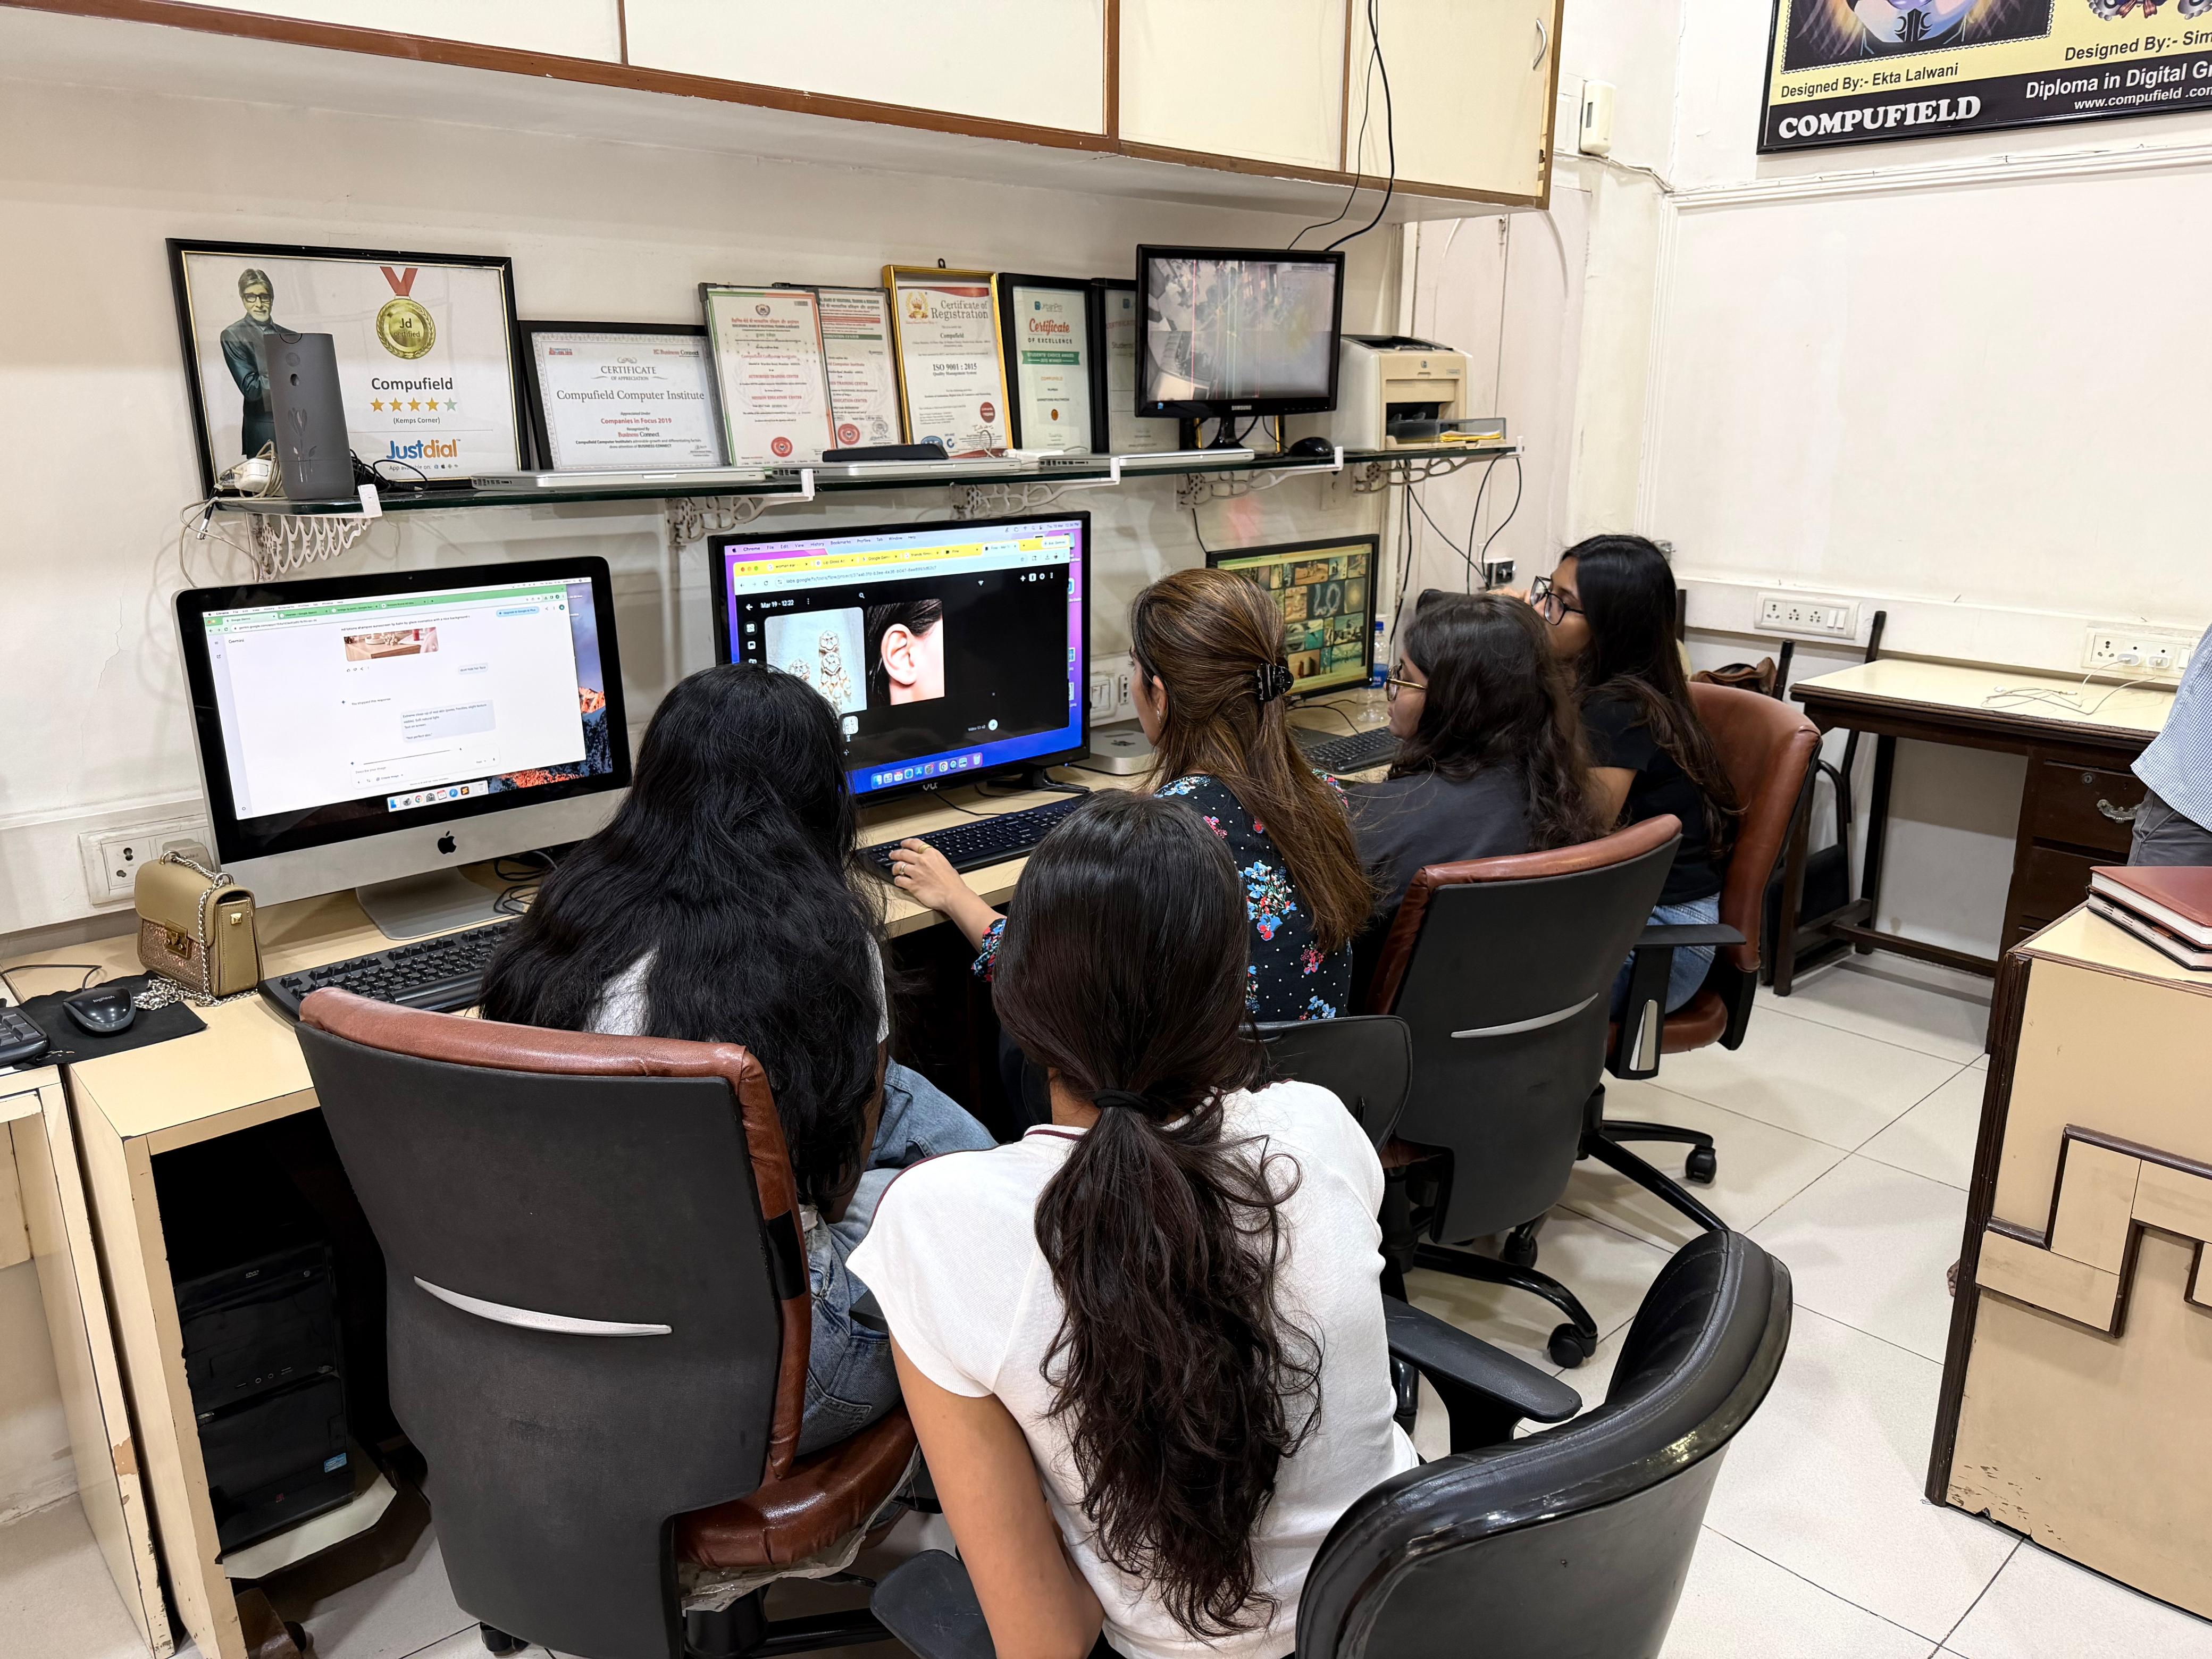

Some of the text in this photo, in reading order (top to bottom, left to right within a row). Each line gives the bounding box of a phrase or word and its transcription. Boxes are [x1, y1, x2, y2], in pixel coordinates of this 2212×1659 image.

[2065, 38, 2139, 61] Designed
[2144, 36, 2177, 53] By:-
[1781, 63, 1959, 98] Designed By:- Ekta Lalwani
[2026, 78, 2098, 100] Diploma
[2104, 72, 2120, 90] in
[2126, 63, 2188, 89] Digital
[2074, 87, 2182, 110] www.compufield
[1779, 96, 1981, 139] COMPUFIELD
[941, 300, 988, 310] Certificate of
[931, 308, 988, 321] Registration
[400, 318, 412, 329] Jd
[1029, 318, 1070, 336] Certificate
[601, 366, 657, 374] CERTIFICATE
[372, 378, 454, 392] Compufield
[557, 390, 705, 403] Compufield Computer Institute
